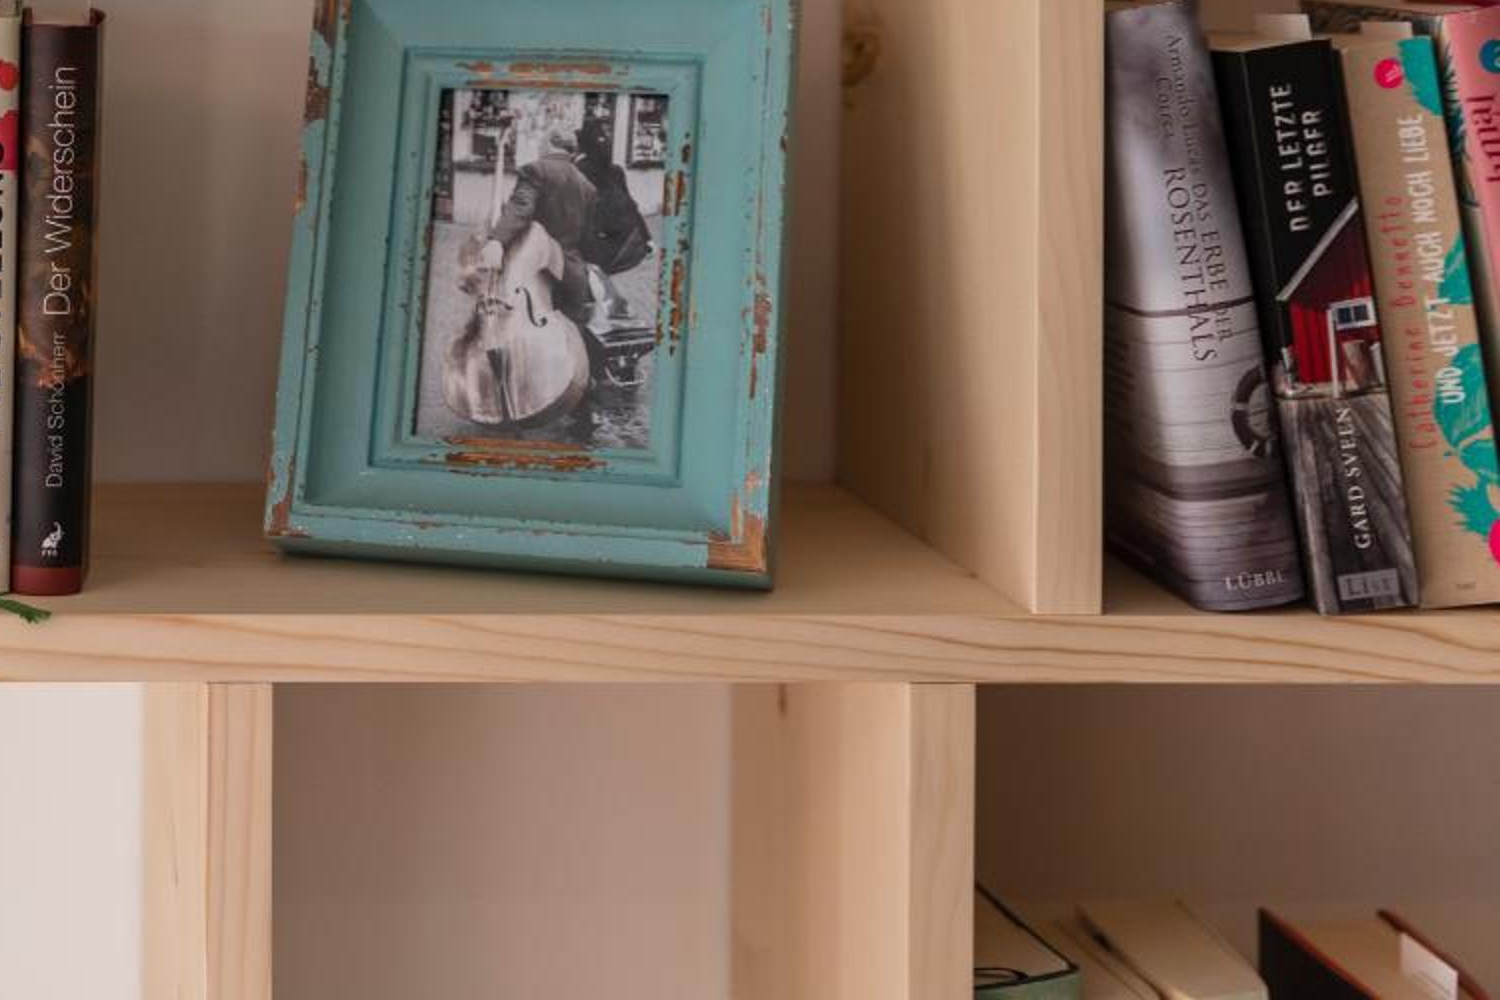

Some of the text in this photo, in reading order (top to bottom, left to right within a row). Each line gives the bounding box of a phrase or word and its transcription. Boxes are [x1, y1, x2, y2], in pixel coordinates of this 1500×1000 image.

[44, 66, 78, 315] Der Widerschein
[1192, 183, 1211, 219] DAS
[1269, 83, 1310, 233] DER LETZTE
[1303, 110, 1333, 198] PILGER
[1164, 167, 1217, 361] ROSENTHALS
[1200, 230, 1230, 290] ERBE
[1397, 113, 1465, 404] UND JETZT AUCH NOCH LIEBE
[1405, 327, 1437, 450] Catherine
[45, 435, 63, 488] David
[1335, 407, 1373, 549] GARD SVEEN
